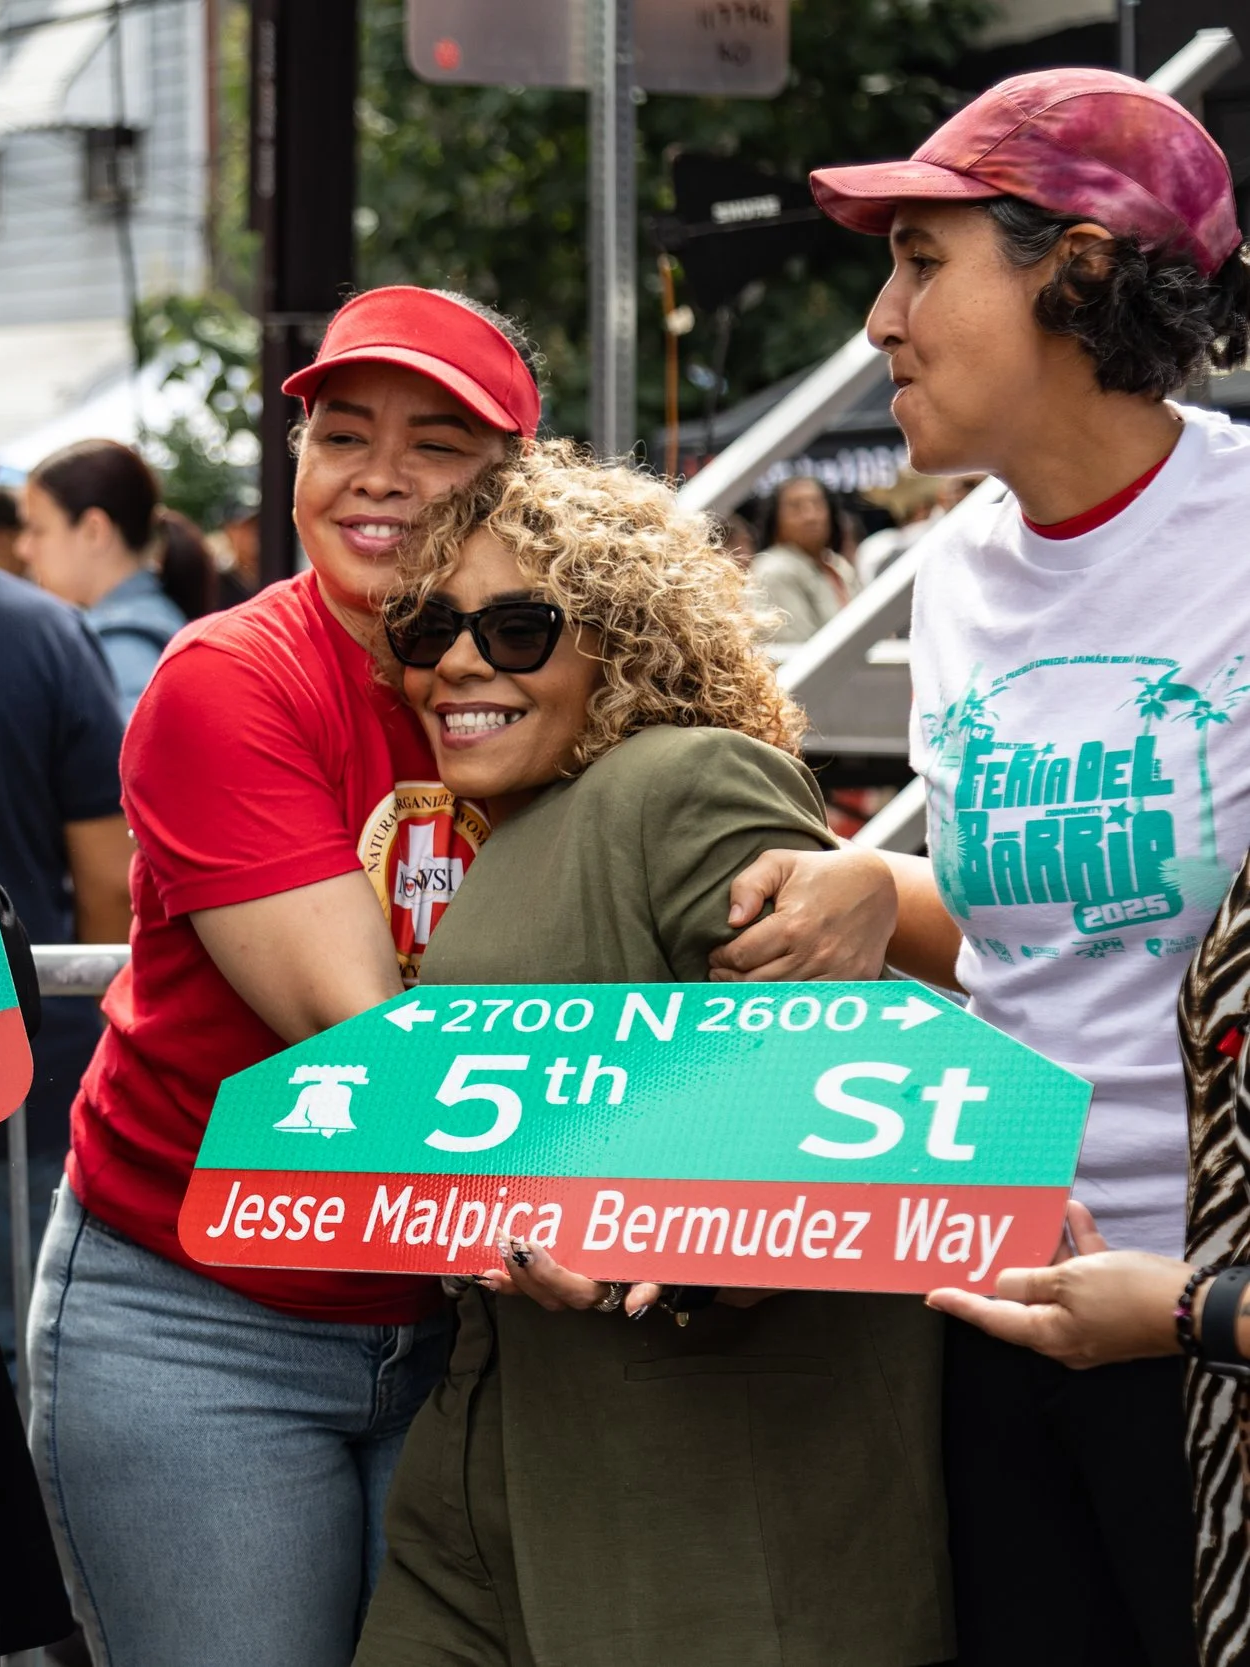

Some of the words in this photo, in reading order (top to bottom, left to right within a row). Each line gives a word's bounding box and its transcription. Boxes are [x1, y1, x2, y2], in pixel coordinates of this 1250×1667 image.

[1036, 656, 1068, 668] UNIDO
[1073, 736, 1174, 803] DEL
[367, 804, 399, 874] NATURA
[396, 793, 456, 810] RGANIZE
[1082, 894, 1170, 929] 2025
[441, 998, 595, 1033] 2700
[615, 991, 684, 1041] N
[697, 996, 868, 1032] 2600
[423, 1054, 628, 1153] 5th
[798, 1061, 989, 1162] St
[206, 1181, 346, 1243] Jesse
[362, 1185, 562, 1262] Malpica
[583, 1189, 872, 1260] Bermudez
[894, 1197, 1013, 1282] Way
